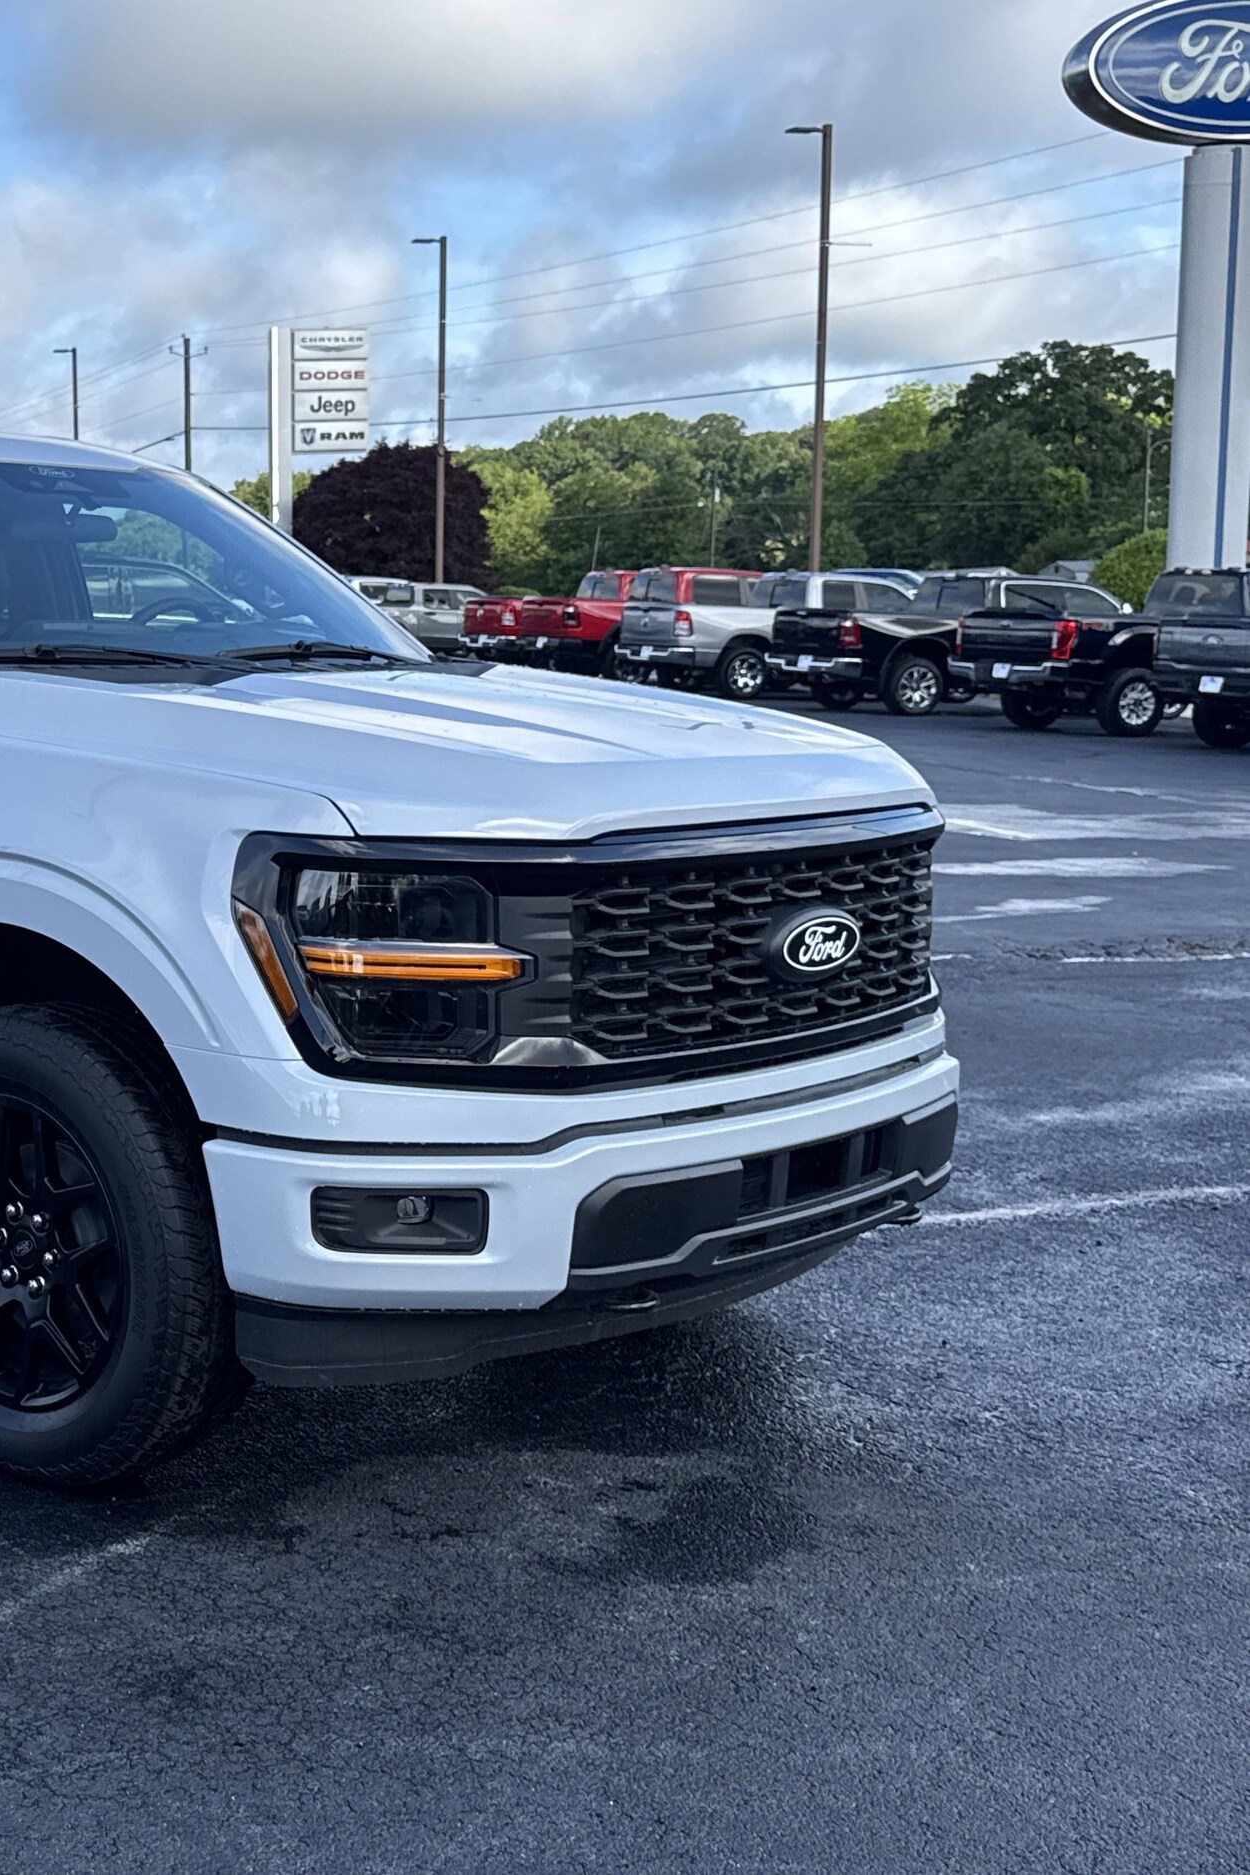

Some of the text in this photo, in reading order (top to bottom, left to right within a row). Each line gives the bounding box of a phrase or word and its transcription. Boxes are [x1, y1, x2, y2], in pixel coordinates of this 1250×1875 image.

[1158, 18, 1250, 104] Fo
[299, 370, 366, 381] DODGE
[310, 395, 355, 416] Jeep
[319, 431, 365, 441] RAM
[799, 924, 848, 963] Ford
